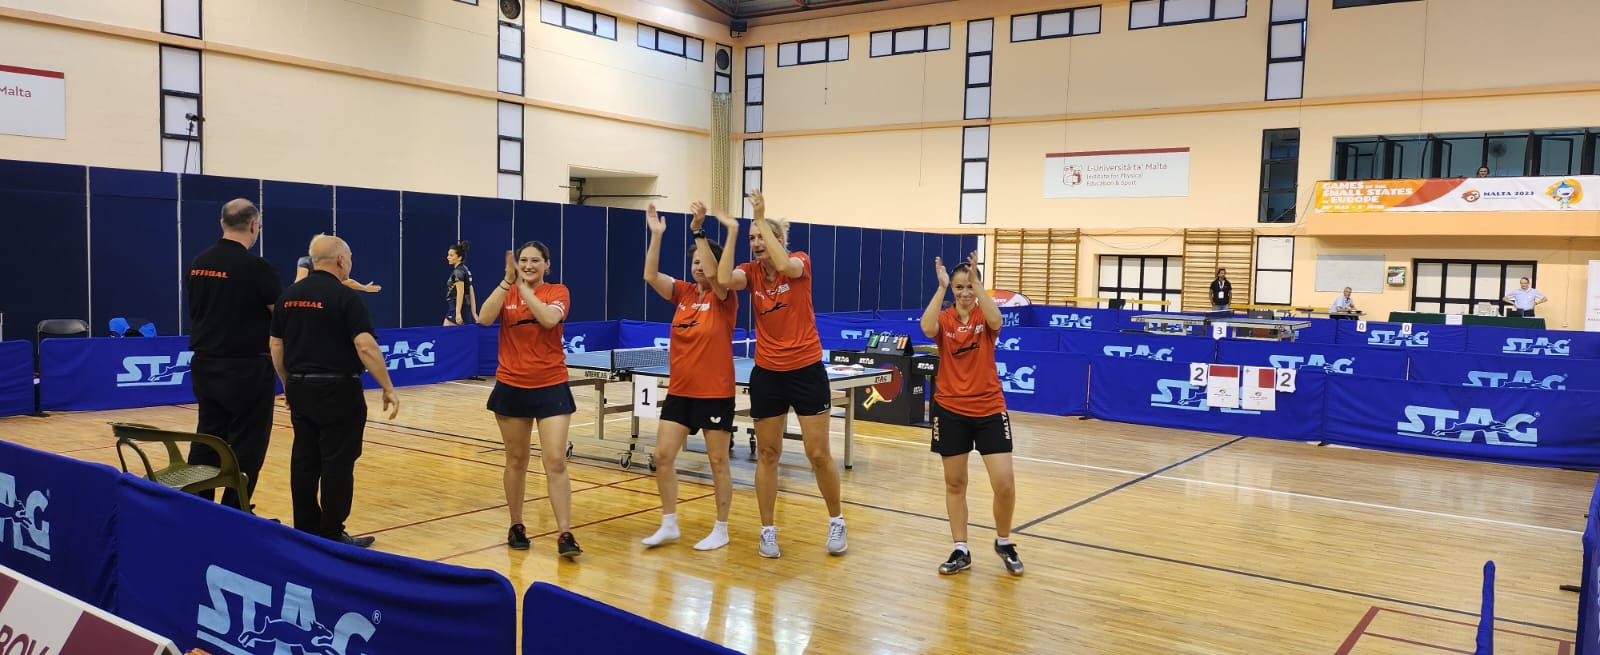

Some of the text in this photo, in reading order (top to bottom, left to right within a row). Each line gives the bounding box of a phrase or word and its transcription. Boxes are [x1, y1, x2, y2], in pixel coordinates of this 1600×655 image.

[1322, 182, 1364, 190] GAMES
[1322, 188, 1413, 197] SMALL STATES
[1331, 196, 1380, 204] EUROPE
[191, 269, 229, 279] OFFICIAL
[283, 300, 323, 309] OFFICIAL
[1049, 313, 1093, 329] STAG
[1216, 326, 1223, 335] 3
[1502, 337, 1570, 356] STAG
[1193, 366, 1205, 382] 2
[1280, 372, 1292, 388] 2
[641, 388, 651, 406] 1
[1396, 404, 1538, 448] STAG
[196, 564, 376, 655] STAG
